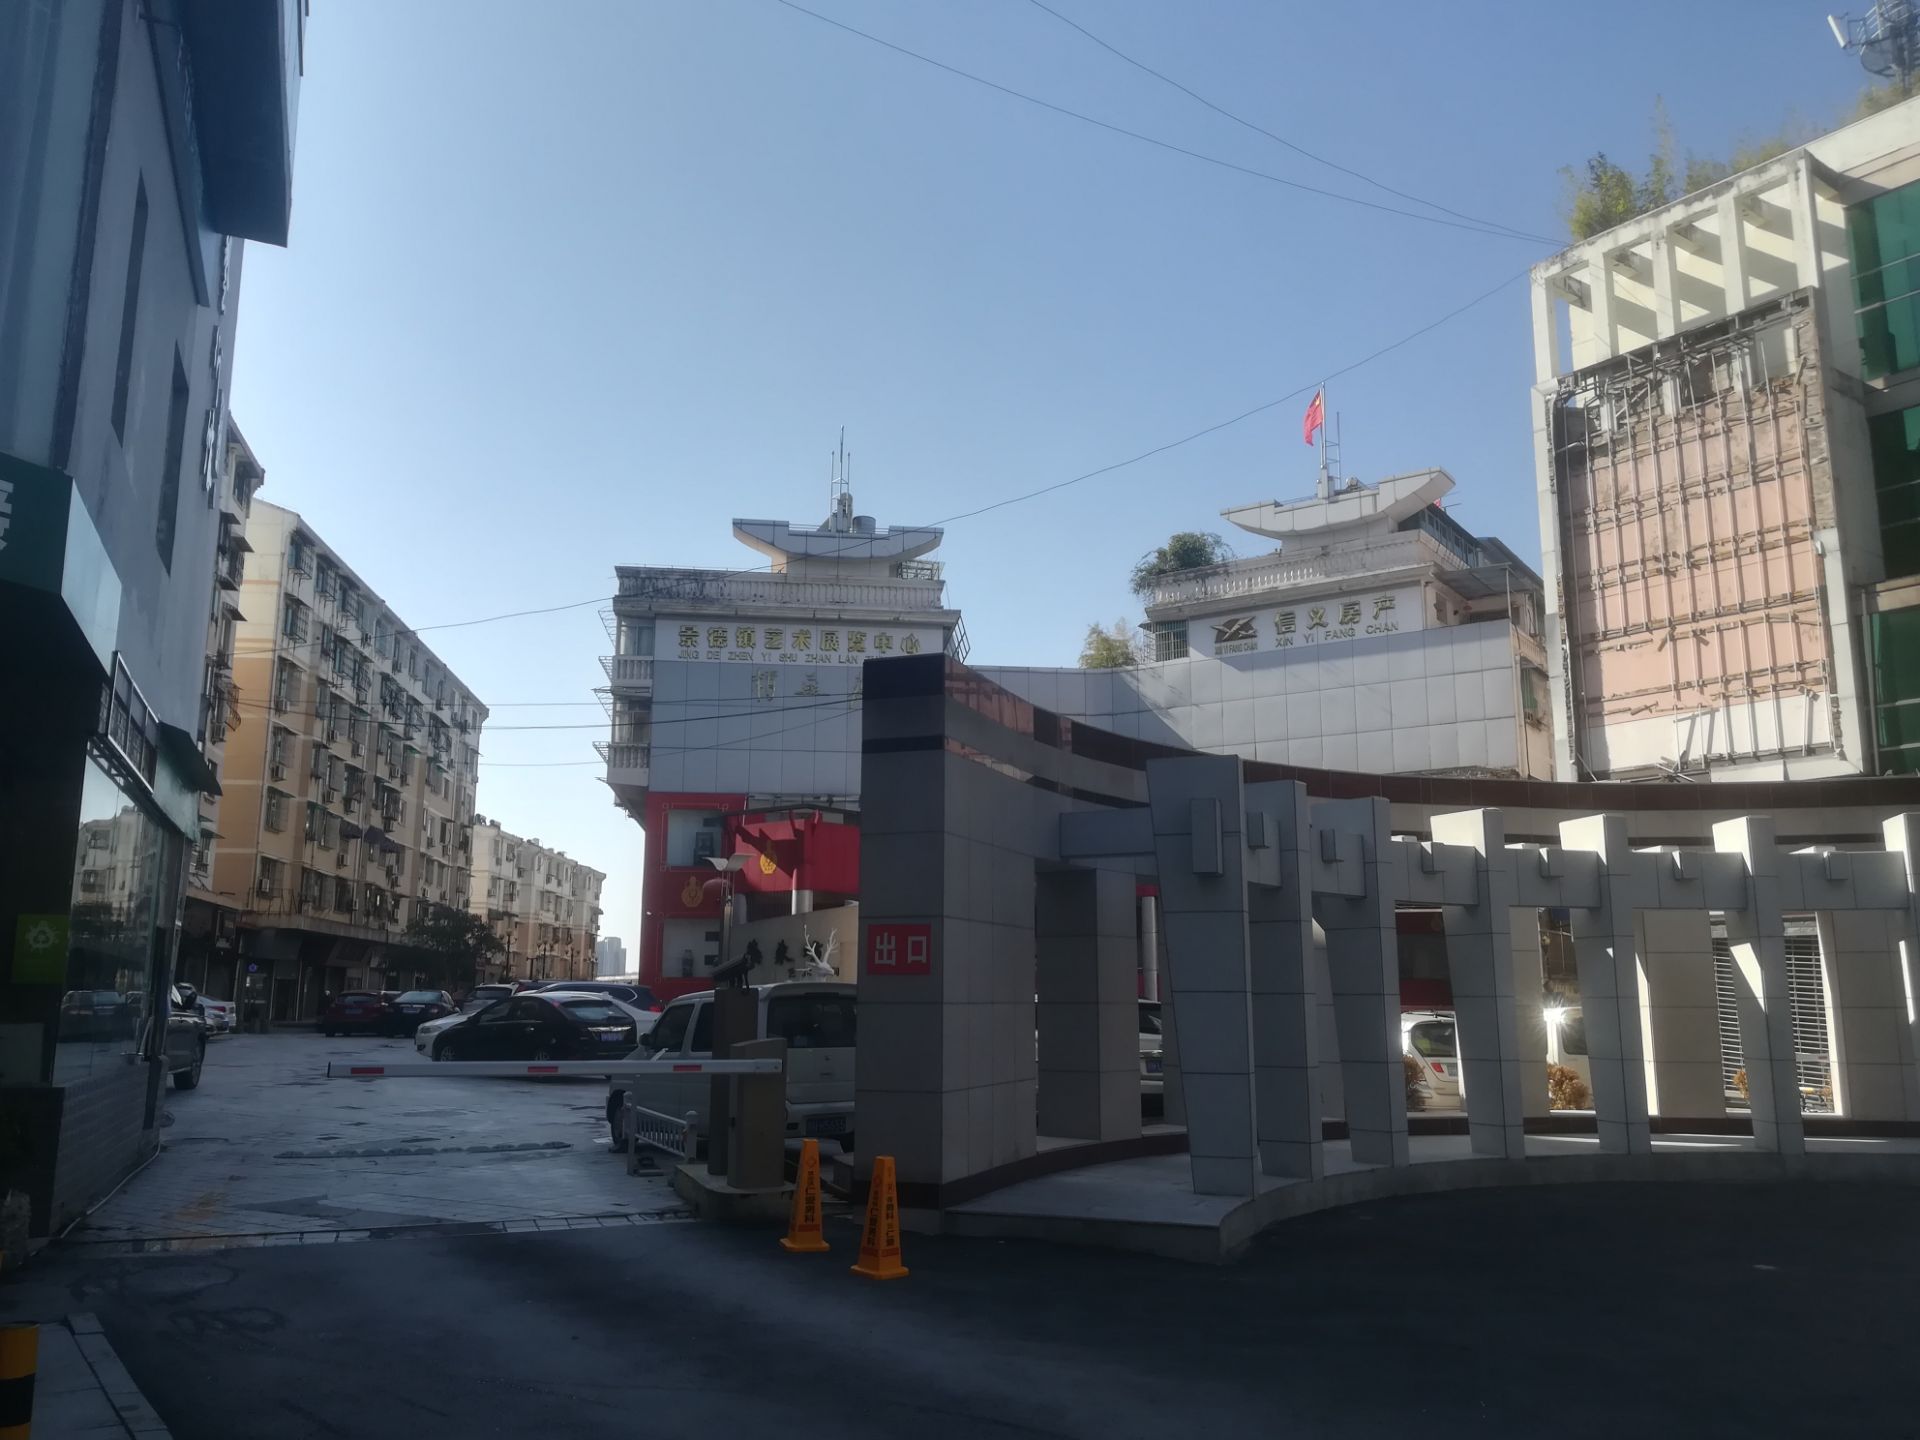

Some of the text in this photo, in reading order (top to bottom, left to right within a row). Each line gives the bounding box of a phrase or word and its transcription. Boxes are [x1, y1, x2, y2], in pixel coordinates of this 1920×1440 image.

[1274, 595, 1396, 635] 信义房产
[678, 624, 921, 654] 景德镇艺术展览中心
[1275, 621, 1399, 648] XIN YI FANG CHAN
[678, 649, 699, 660] JING
[707, 650, 721, 660] DE
[728, 651, 753, 661] ZHEN
[761, 652, 772, 662] YI
[779, 652, 798, 663] SHU
[805, 653, 832, 664] ZHAN
[839, 654, 858, 665] LAN
[874, 932, 927, 965] 出口
